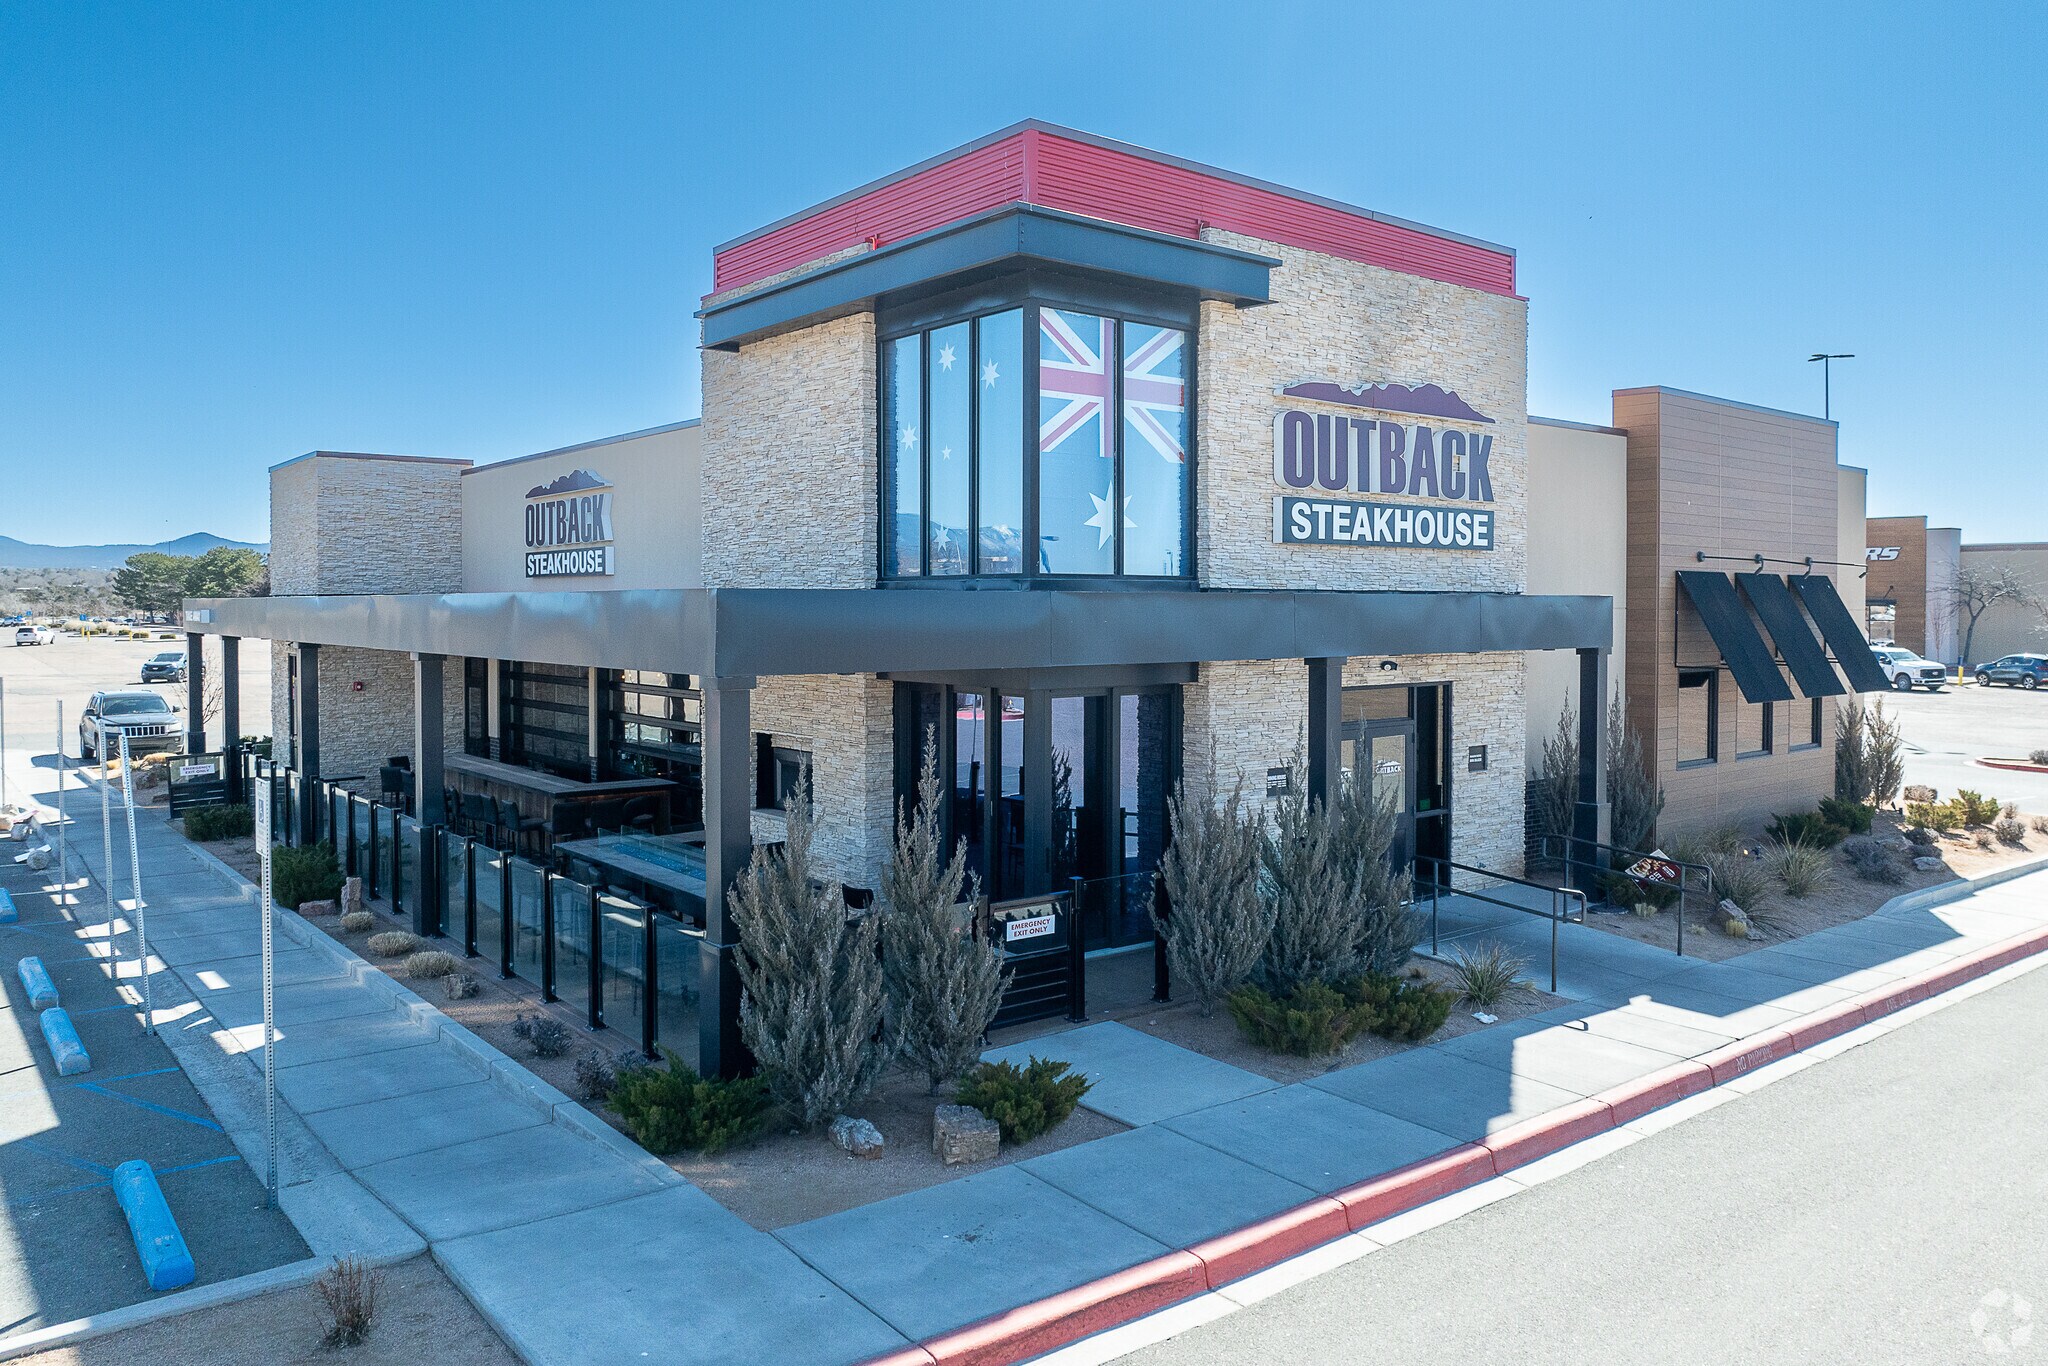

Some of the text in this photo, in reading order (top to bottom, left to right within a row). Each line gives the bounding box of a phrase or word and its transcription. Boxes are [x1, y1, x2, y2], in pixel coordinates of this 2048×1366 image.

[1282, 410, 1495, 502] OUTBACK
[525, 493, 605, 547] OUTBACK
[1290, 502, 1489, 547] STEAKHOUSE
[527, 549, 603, 576] STEAKHOUSE
[1011, 918, 1051, 930] EMERGENCY
[1029, 926, 1048, 935] ONLY
[1735, 1055, 1746, 1072] NO
